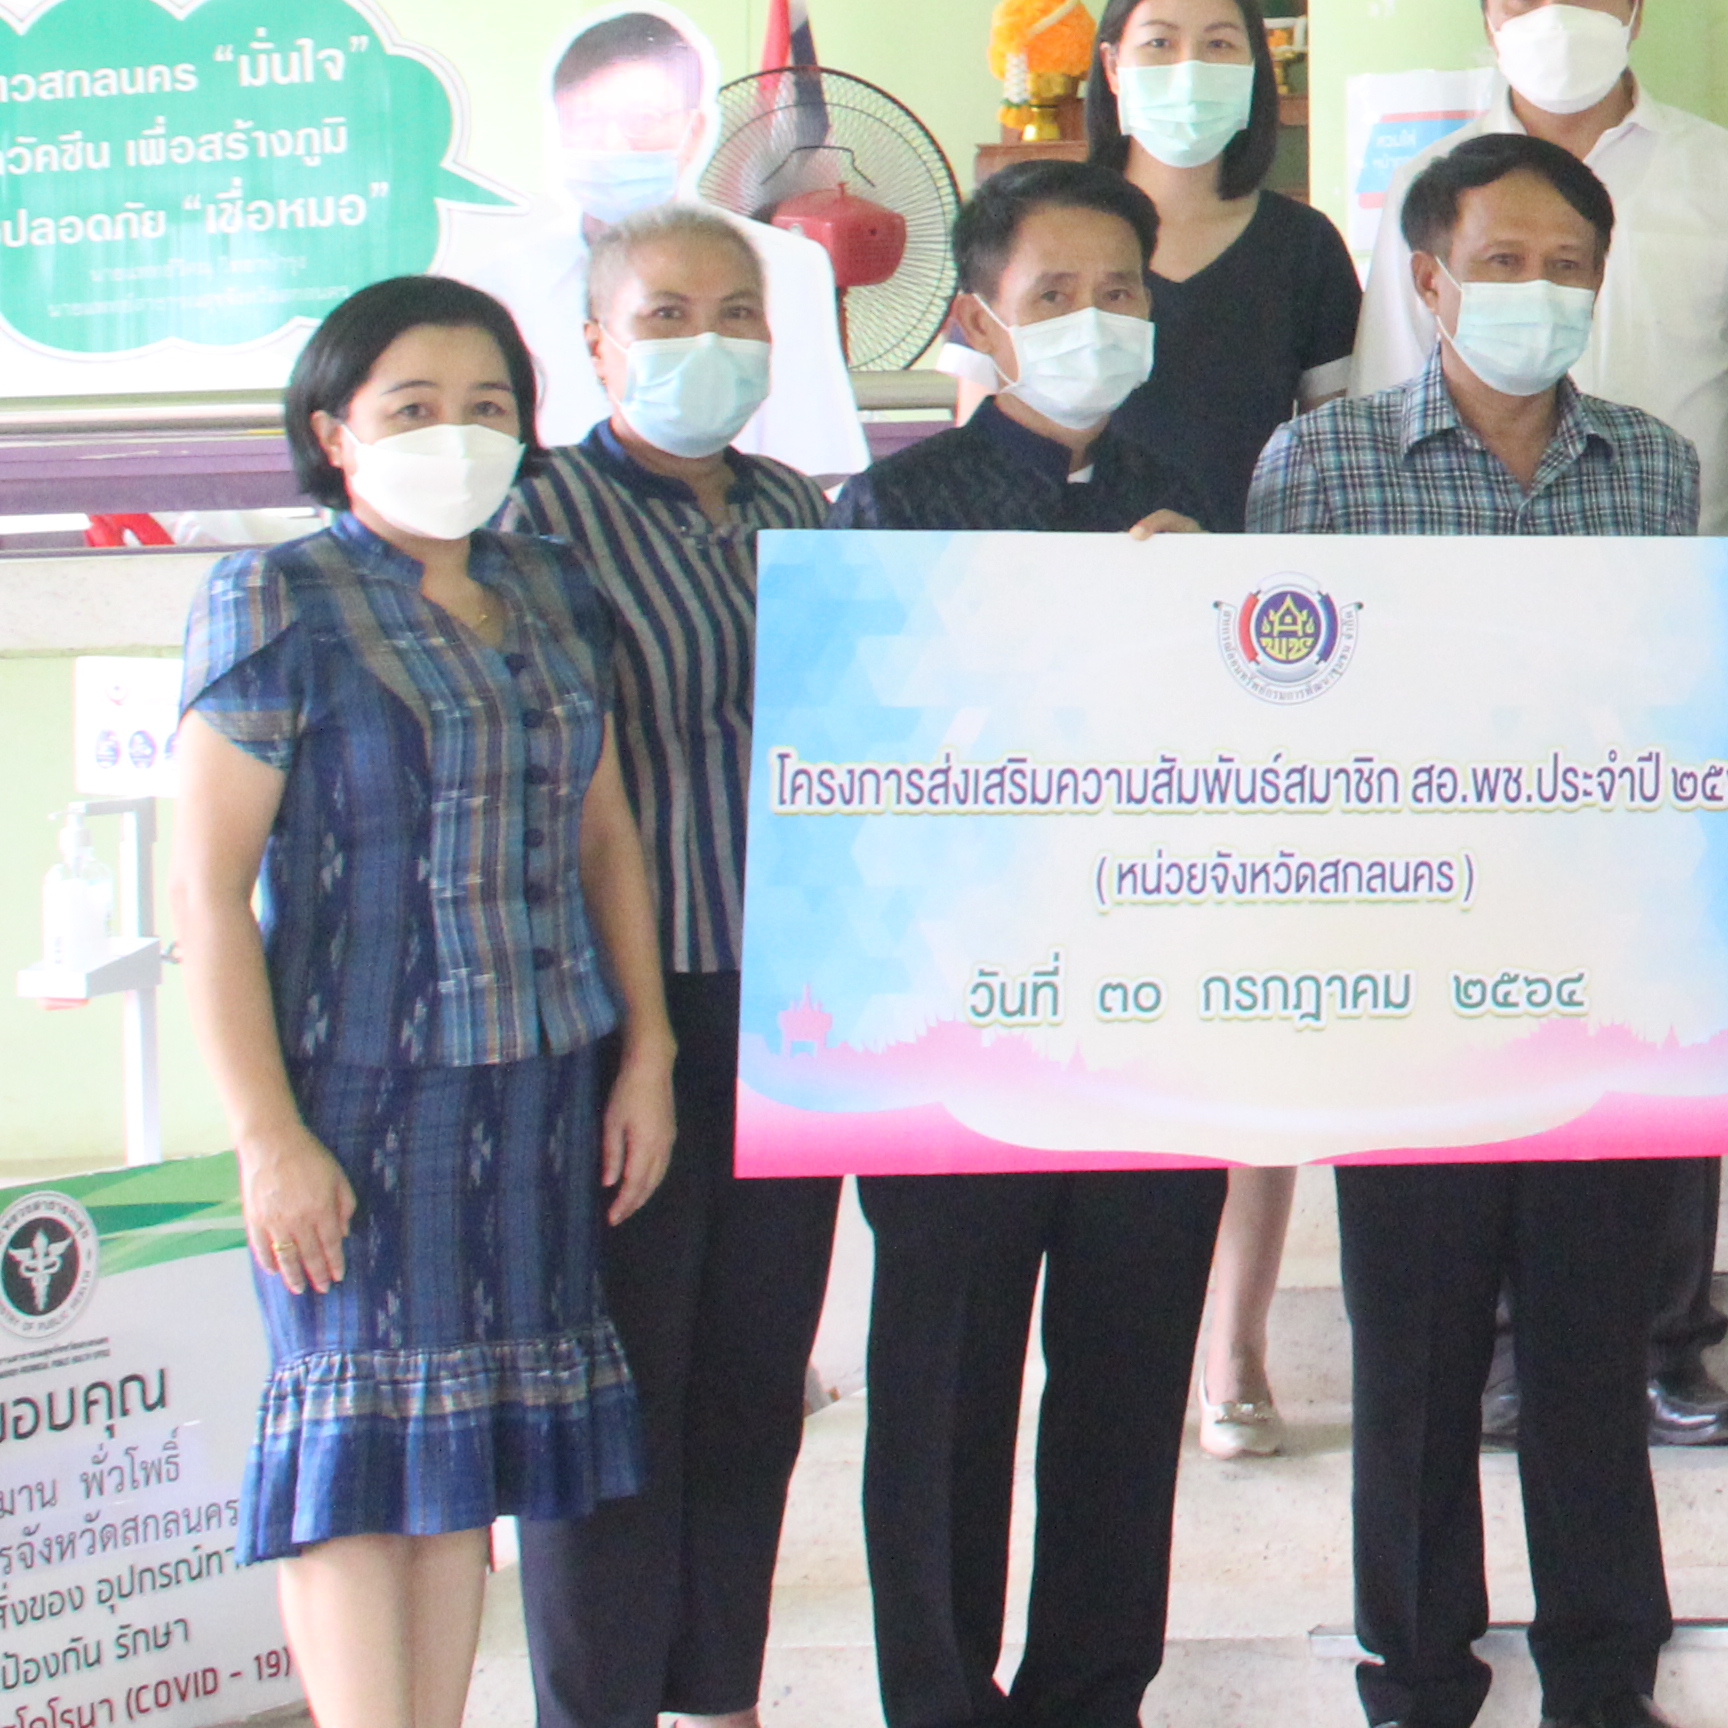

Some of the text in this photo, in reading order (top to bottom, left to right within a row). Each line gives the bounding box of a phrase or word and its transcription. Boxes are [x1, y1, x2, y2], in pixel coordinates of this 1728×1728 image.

[213, 26, 369, 87] “มั่นใจ”
[0, 115, 349, 175] วัคซีน เพื่อสร้างภูมิ
[0, 176, 389, 248] ปลอดภัย “เชื่อหมอ”
[776, 751, 1399, 806] โครงการส่งเสริมความสัมพันธ์สมาชิก
[1411, 749, 1660, 804] สอ.พช.ประจำปี
[970, 951, 1586, 1022] วันที่ ๓๐ กรกฎาคม ๒๕๖๔
[115, 1617, 190, 1661] รักษา
[0, 1697, 114, 1728] โคโรนา
[126, 1667, 220, 1719] (COVID
[254, 1645, 292, 1682] 19)
